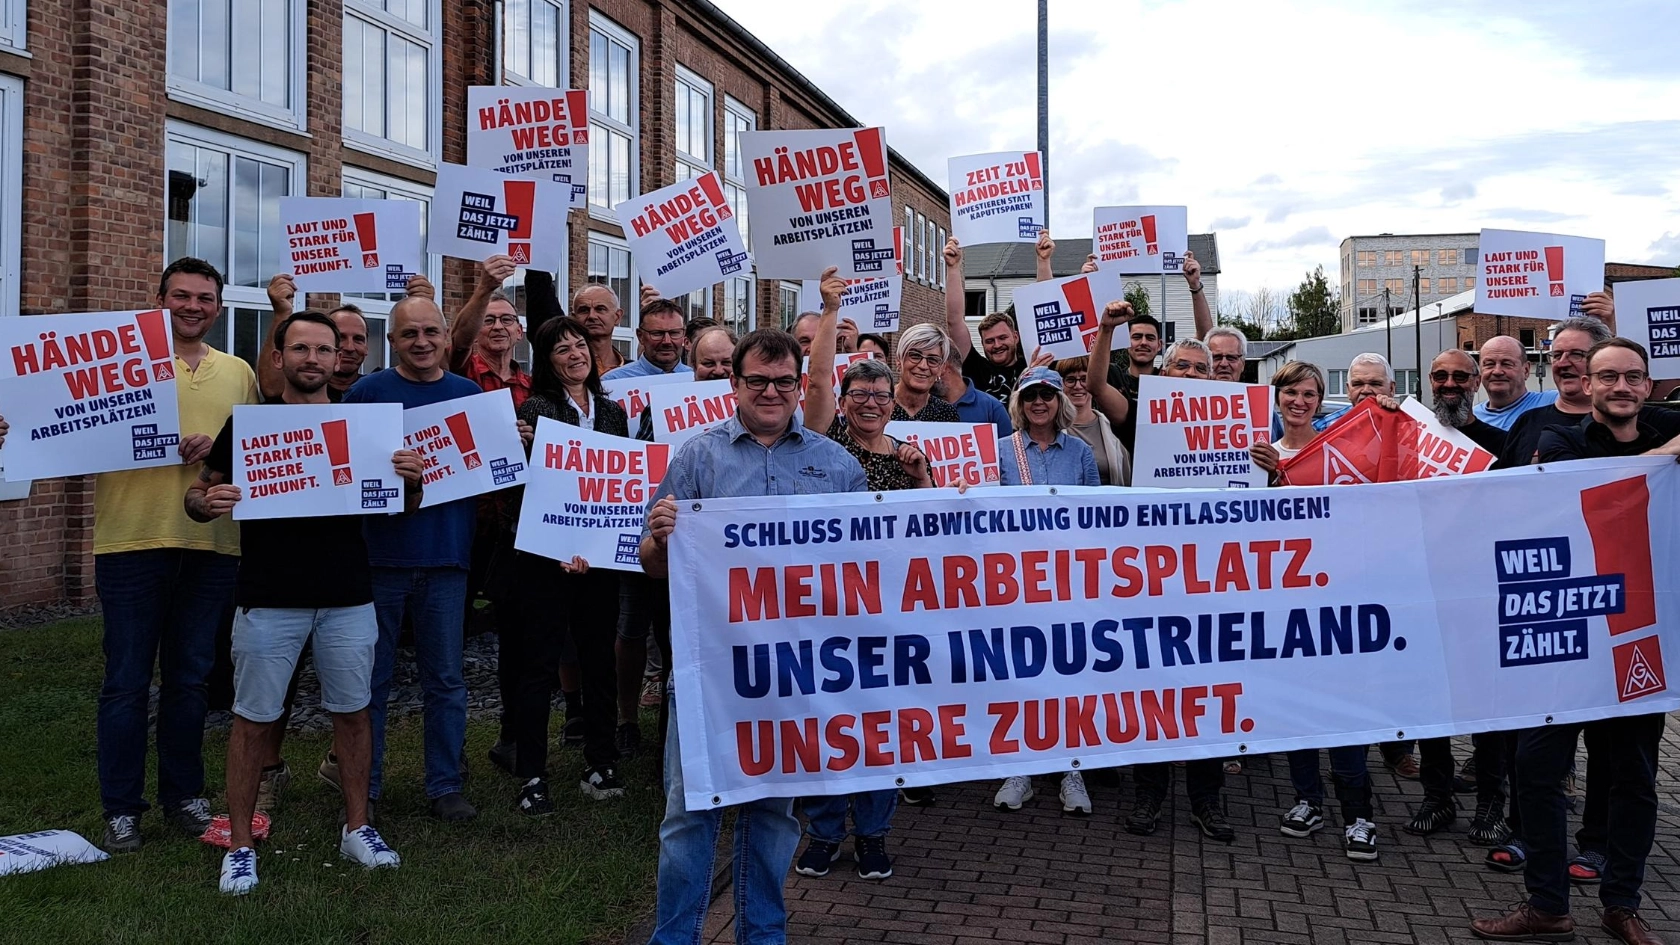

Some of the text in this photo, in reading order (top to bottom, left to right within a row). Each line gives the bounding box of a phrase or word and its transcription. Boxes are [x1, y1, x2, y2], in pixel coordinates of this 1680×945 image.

[479, 98, 567, 130] HÄNDE
[511, 124, 569, 151] WEG
[503, 148, 571, 164] VON UNSEREN
[754, 141, 859, 186] HÄNDE
[554, 175, 569, 183] WEIL
[966, 161, 1026, 186] ZEIT ZU
[795, 175, 866, 212] WEG
[954, 178, 1030, 207] HANDELN
[465, 195, 490, 208] WEIL
[957, 194, 1031, 216] INVESTIEREN STATT
[462, 211, 516, 228] DAS JETZT
[631, 186, 706, 237] HÄNDE
[790, 205, 869, 229] VON UNSEREN
[970, 202, 1033, 220] KAPUTTSPAREN!
[287, 219, 347, 235] LAUT UND
[460, 225, 495, 241] ZÄHLT.
[665, 208, 717, 245] WEG
[773, 218, 873, 246] ARBEITSPLÄTZEN!
[1098, 220, 1137, 233] LAUT UND
[289, 230, 355, 248] STARK FÜR
[666, 226, 722, 259] VON UNSEREN
[1099, 229, 1142, 242] STARK FÜR
[853, 241, 873, 249] WEIL
[1100, 240, 1131, 252] UNSERE
[292, 247, 339, 262] UNSERE
[657, 235, 727, 276] ARBEITSPLÄTZEN!
[855, 250, 892, 260] DAS JETZT
[1101, 249, 1140, 261] ZUKUNFT.
[1484, 250, 1538, 262] LAUT UND
[294, 259, 352, 276] ZUKUNFT.
[856, 262, 881, 271] ZÄHLT.
[1485, 261, 1545, 275] STARK FÜR
[854, 280, 889, 294] UNSEREN
[1486, 275, 1528, 287] UNSERE
[1487, 287, 1539, 299] ZUKUNFT.
[1036, 305, 1058, 316] WEIL
[1650, 310, 1680, 321] WEIL
[1038, 314, 1082, 330] DAS JETZT
[1040, 331, 1070, 344] ZÄHLT.
[1651, 327, 1677, 339] DAS
[11, 324, 141, 376] HÄNDE
[1653, 343, 1680, 356] ZÄH
[64, 358, 149, 400] WEG
[55, 388, 153, 419] VON UNSEREN
[1149, 391, 1246, 424] HÄNDE
[664, 393, 738, 433] HÄND
[31, 403, 157, 441] ARBEITSPLÄTZEN!
[134, 426, 155, 436] WEIL
[242, 429, 314, 450] LAUT UND
[414, 425, 441, 443] UND
[1184, 424, 1248, 451] WEG
[135, 436, 177, 447] DAS JETZT
[427, 436, 452, 453] FÜR
[136, 449, 164, 459] ZÄHLT.
[244, 442, 324, 467] STARK FÜR
[545, 439, 643, 475] HÄNDE
[1173, 451, 1249, 464] VON UNSEREN
[247, 462, 304, 482] UNSERE
[491, 460, 507, 468] WEIL
[493, 464, 522, 476] DAS JETZT
[1154, 463, 1250, 478] ARBEITSPLÄTZEN!
[422, 464, 455, 485] UNFT.
[931, 461, 980, 488] WEG
[250, 476, 320, 498] ZUKUNFT.
[378, 490, 396, 498] JETZT
[578, 477, 643, 503] WEG
[363, 500, 386, 508] ZÄHLT.
[564, 503, 643, 515] VON UNSEREN
[542, 513, 643, 528] ARBEITSPLÄTZEN!
[724, 496, 1330, 548] SCHLUSS MIT ABWICKLUNG UND ENTLASSUNGEN!
[620, 535, 638, 543] WEIL
[618, 545, 633, 553] DAS
[1501, 547, 1563, 575] WEIL
[728, 538, 1329, 623] MEIN ARBEITSPLATZ.
[1505, 583, 1620, 618] DAS JETZT
[732, 603, 1406, 699] UNSER INDUSTRIELAND.
[1506, 628, 1581, 660] ZÄHLT.
[735, 682, 1254, 777] UNSERE ZUKUNFT.
